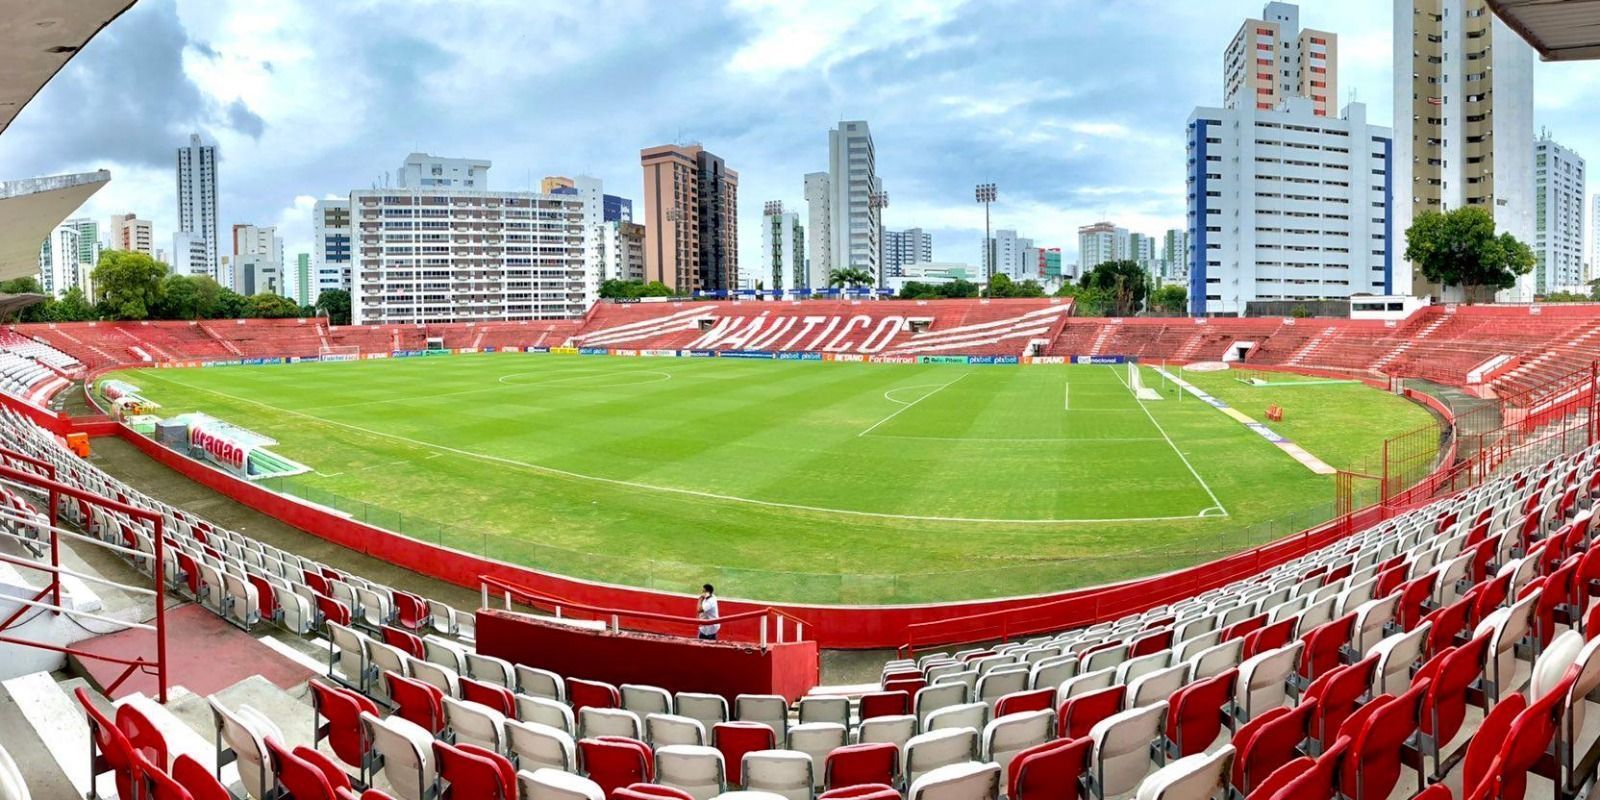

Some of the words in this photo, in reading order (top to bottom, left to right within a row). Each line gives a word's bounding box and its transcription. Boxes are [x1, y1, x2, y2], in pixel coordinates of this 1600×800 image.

[683, 311, 904, 354] NÁUTICO
[834, 354, 864, 362] BETANO
[969, 356, 992, 364] pixbet
[994, 356, 1017, 364] pixbet
[1032, 356, 1065, 364] BETANO
